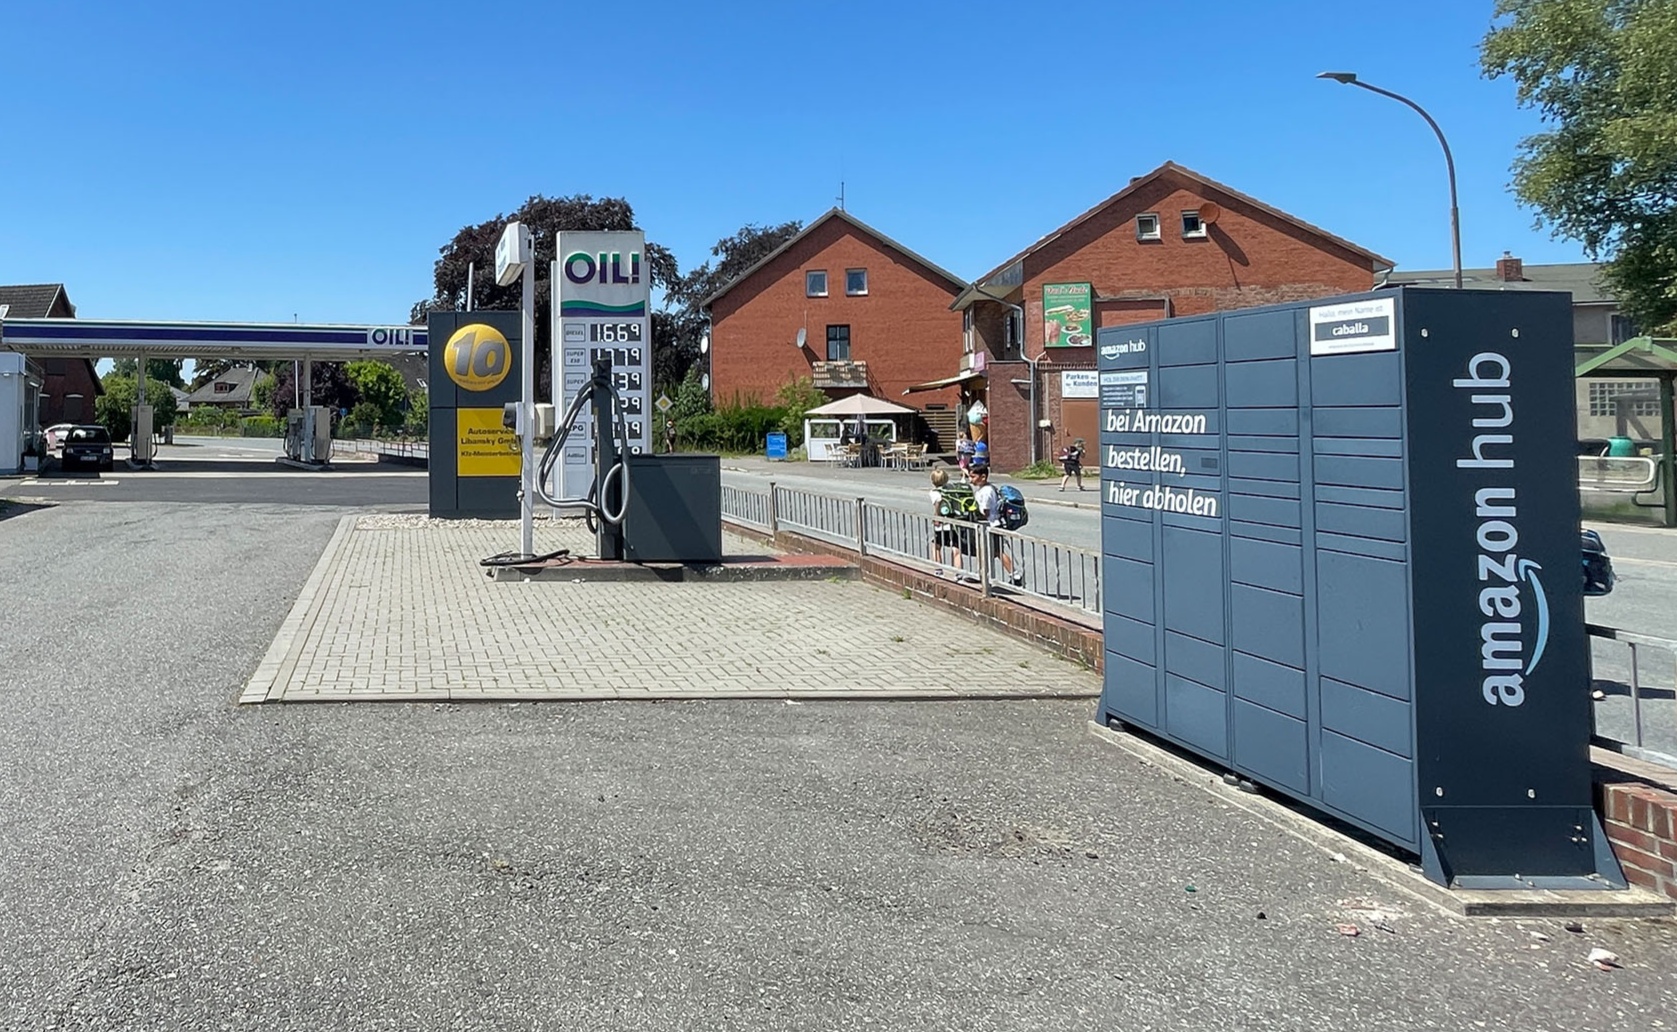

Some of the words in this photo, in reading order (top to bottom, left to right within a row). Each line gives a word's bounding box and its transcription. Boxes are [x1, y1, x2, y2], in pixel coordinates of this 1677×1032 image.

[564, 252, 640, 285] OIL!
[1355, 306, 1374, 314] Name
[371, 329, 410, 346] OIL!
[1332, 322, 1369, 336] caballa
[452, 331, 506, 378] 1a
[1100, 344, 1128, 355] amazon
[1129, 339, 1146, 352] hub
[1107, 408, 1130, 432] bei
[1133, 411, 1206, 434] Amazon
[1452, 351, 1515, 469] hub
[460, 438, 496, 446] Libansky
[1107, 445, 1186, 478] bestellen,
[1108, 481, 1140, 507] hier
[1143, 485, 1217, 517] abholen
[1474, 486, 1525, 708] amazon
